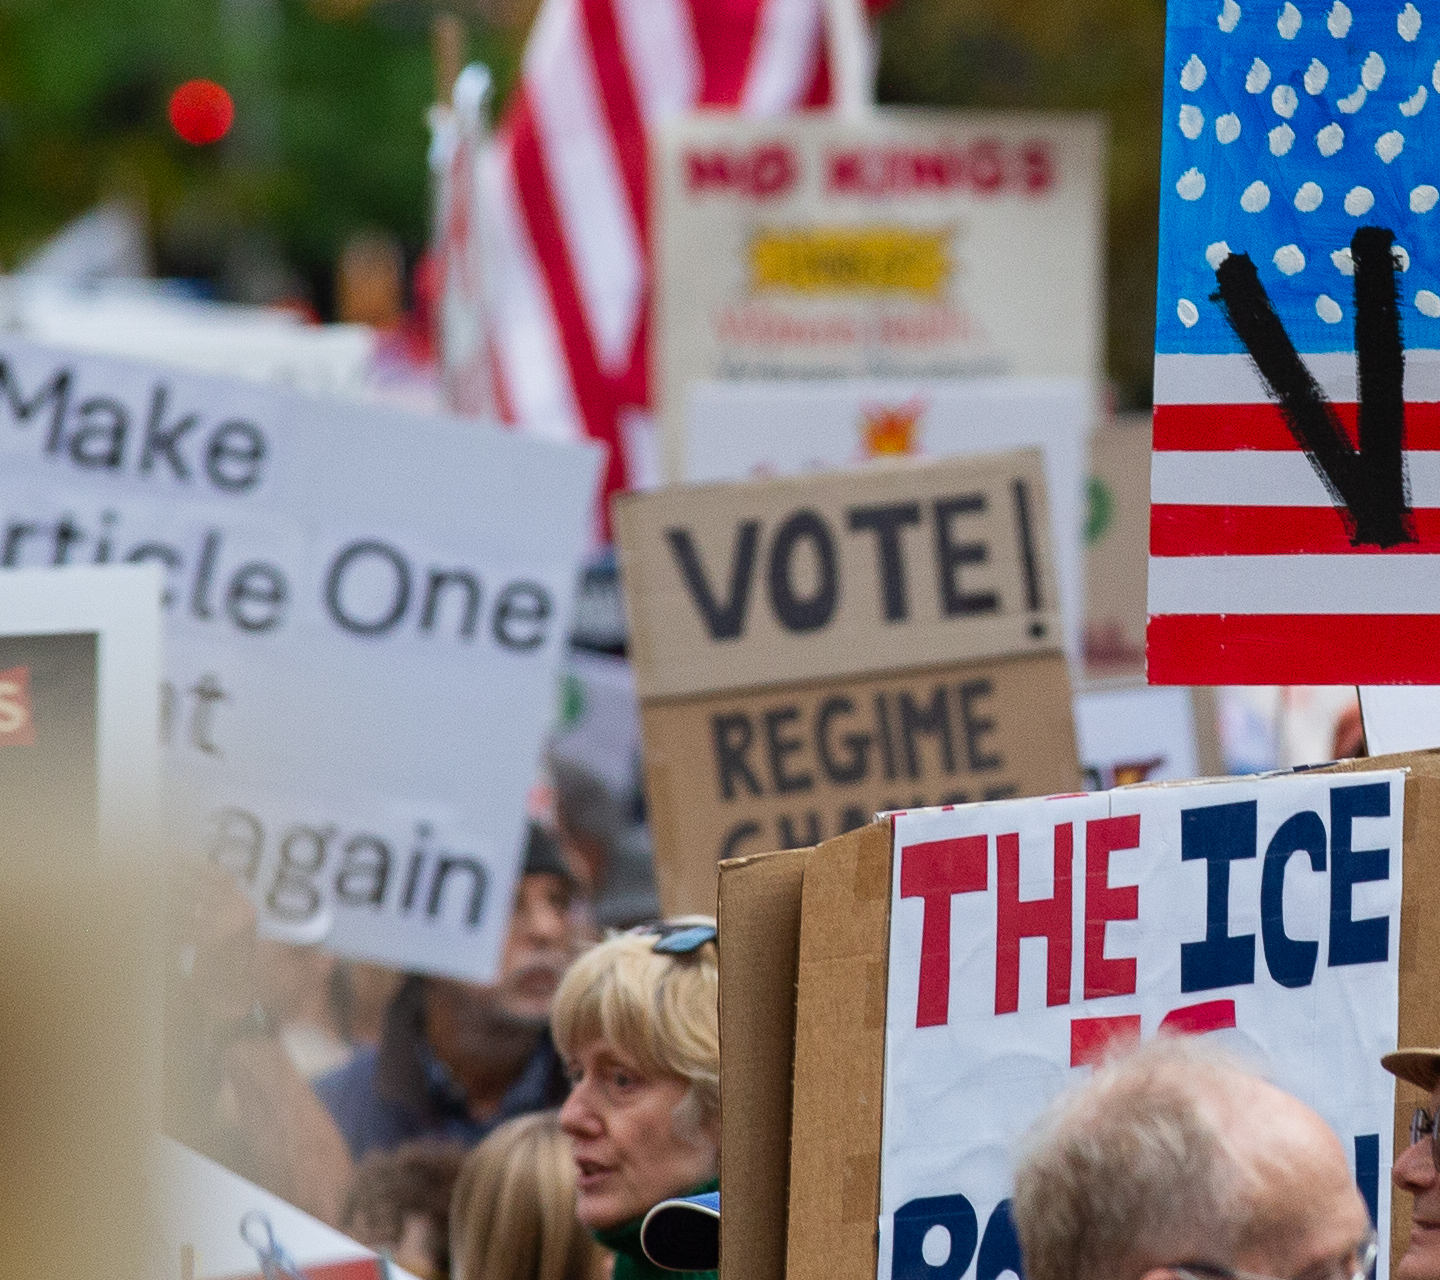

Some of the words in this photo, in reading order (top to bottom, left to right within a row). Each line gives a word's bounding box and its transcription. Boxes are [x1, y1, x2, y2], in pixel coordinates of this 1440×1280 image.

[323, 539, 556, 653] One
[664, 477, 1049, 643] VOTE!
[710, 678, 1005, 802] REGIME
[210, 805, 492, 930] again
[899, 813, 1142, 1030] THE
[1179, 780, 1392, 995] ICE
